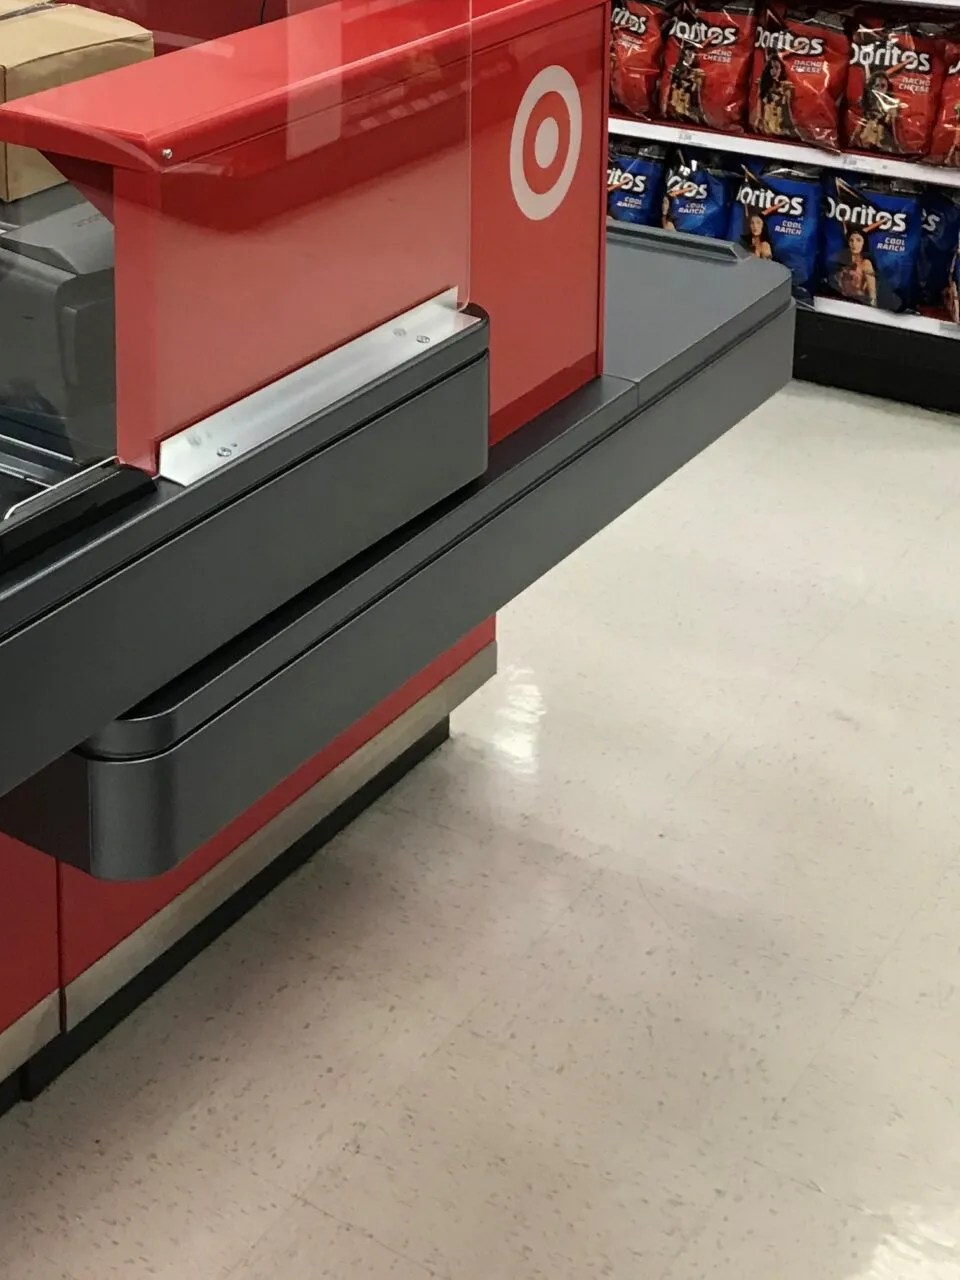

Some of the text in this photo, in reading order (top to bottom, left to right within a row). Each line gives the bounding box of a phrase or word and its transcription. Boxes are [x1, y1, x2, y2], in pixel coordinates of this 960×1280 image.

[703, 54, 732, 64] CHEESE
[794, 58, 822, 68] NACHO
[902, 76, 931, 86] NACHO
[898, 83, 931, 93] CHEESE
[781, 220, 803, 229] COOL
[774, 225, 803, 236] RANCH
[884, 236, 906, 247] COOL
[876, 242, 906, 252] RANCH
